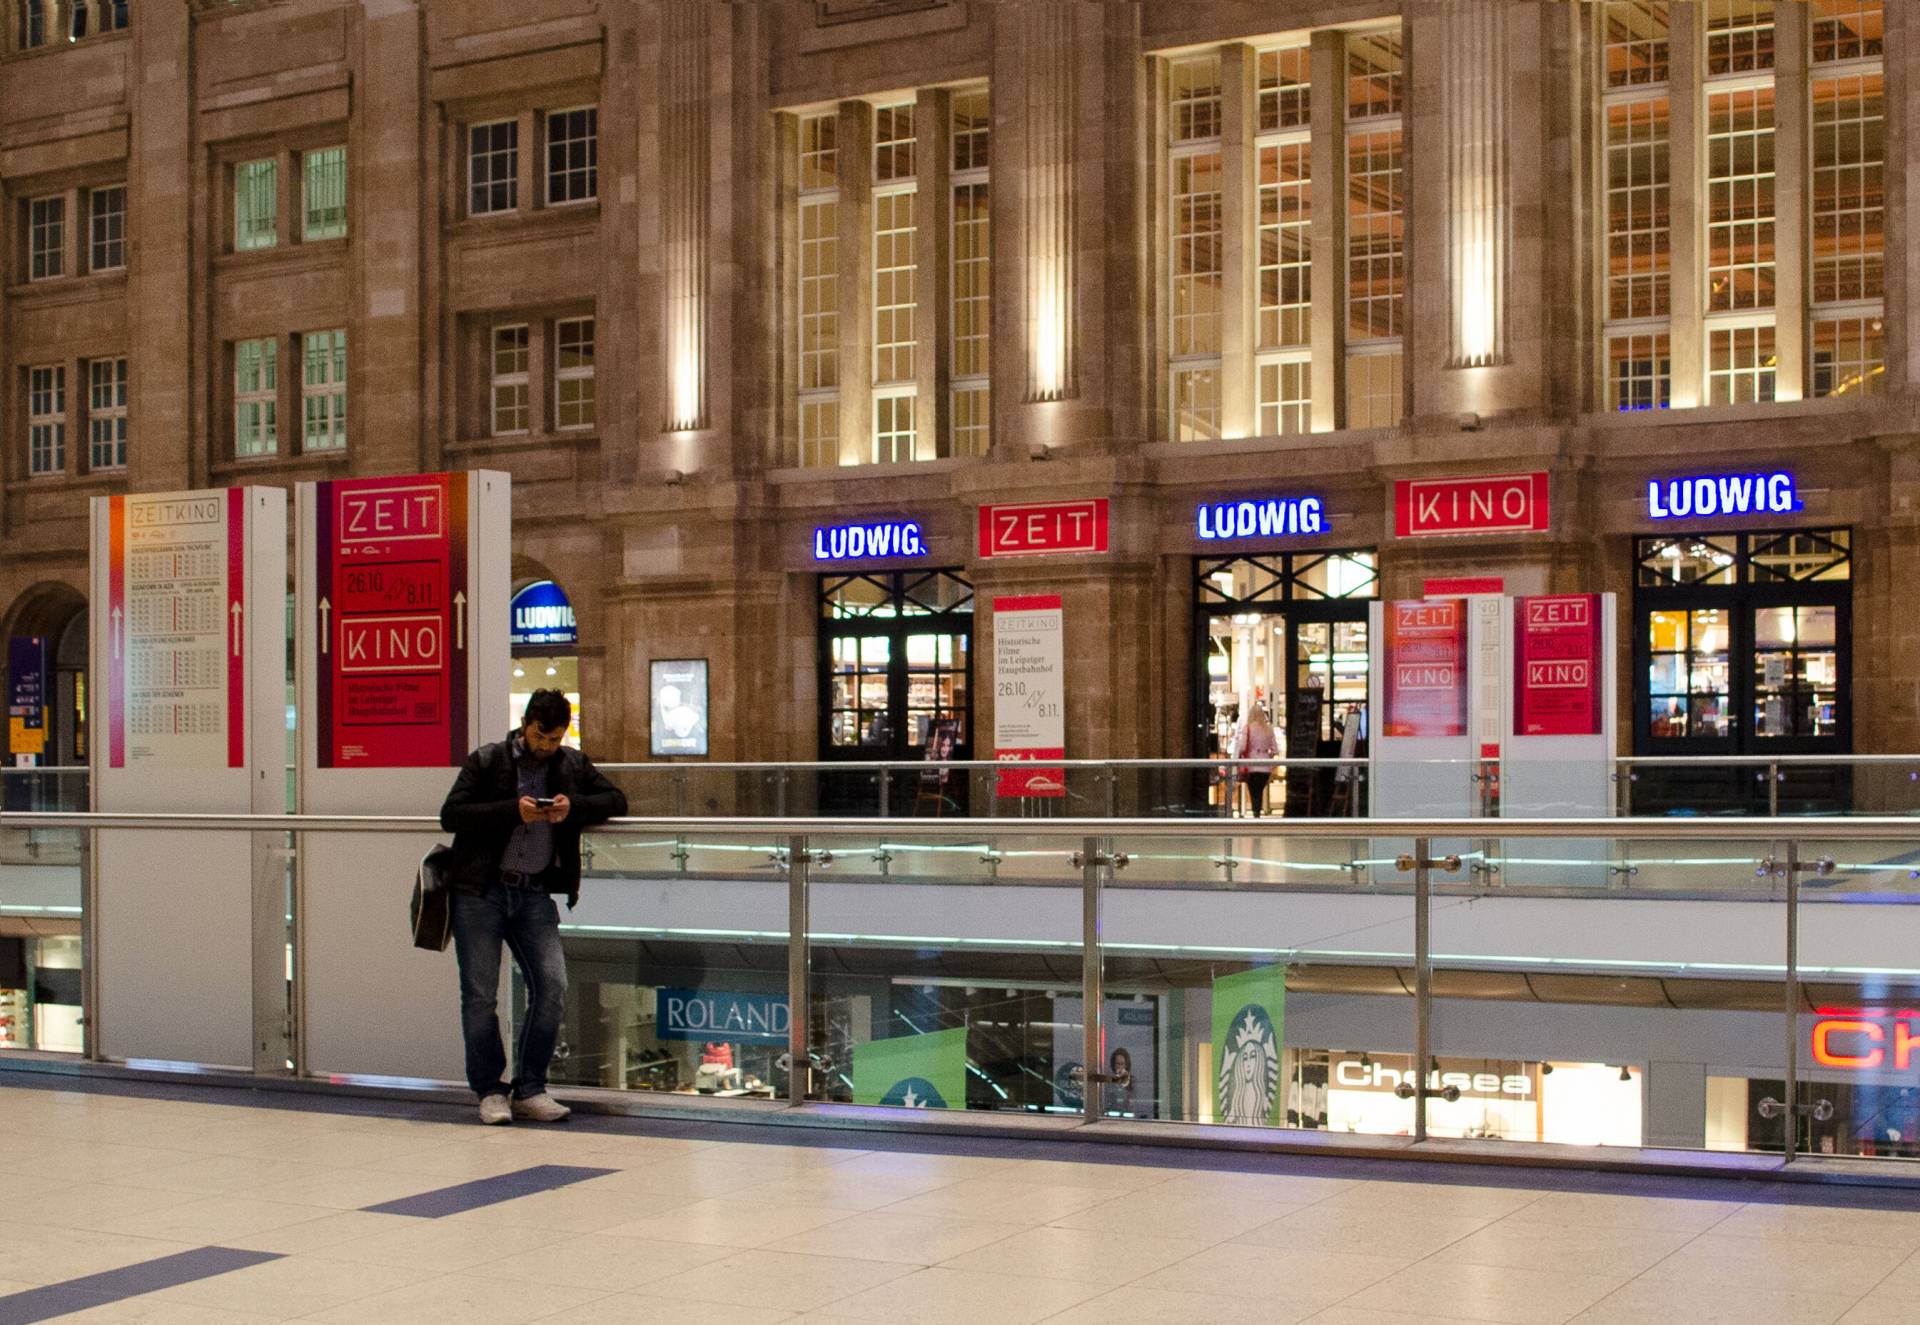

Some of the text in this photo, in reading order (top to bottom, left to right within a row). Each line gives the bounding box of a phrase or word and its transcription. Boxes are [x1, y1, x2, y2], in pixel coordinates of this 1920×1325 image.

[135, 503, 217, 524] ZEITKINO
[348, 496, 435, 532] ZEIT
[1418, 487, 1527, 524] KINO
[999, 511, 1089, 546] ZEIT
[1401, 608, 1451, 626] ZEIT
[1532, 603, 1584, 622] ZEIT
[348, 627, 436, 660] KINO
[1401, 668, 1451, 685] KINO
[1532, 665, 1584, 682] KINO
[668, 998, 789, 1032] ROLAND
